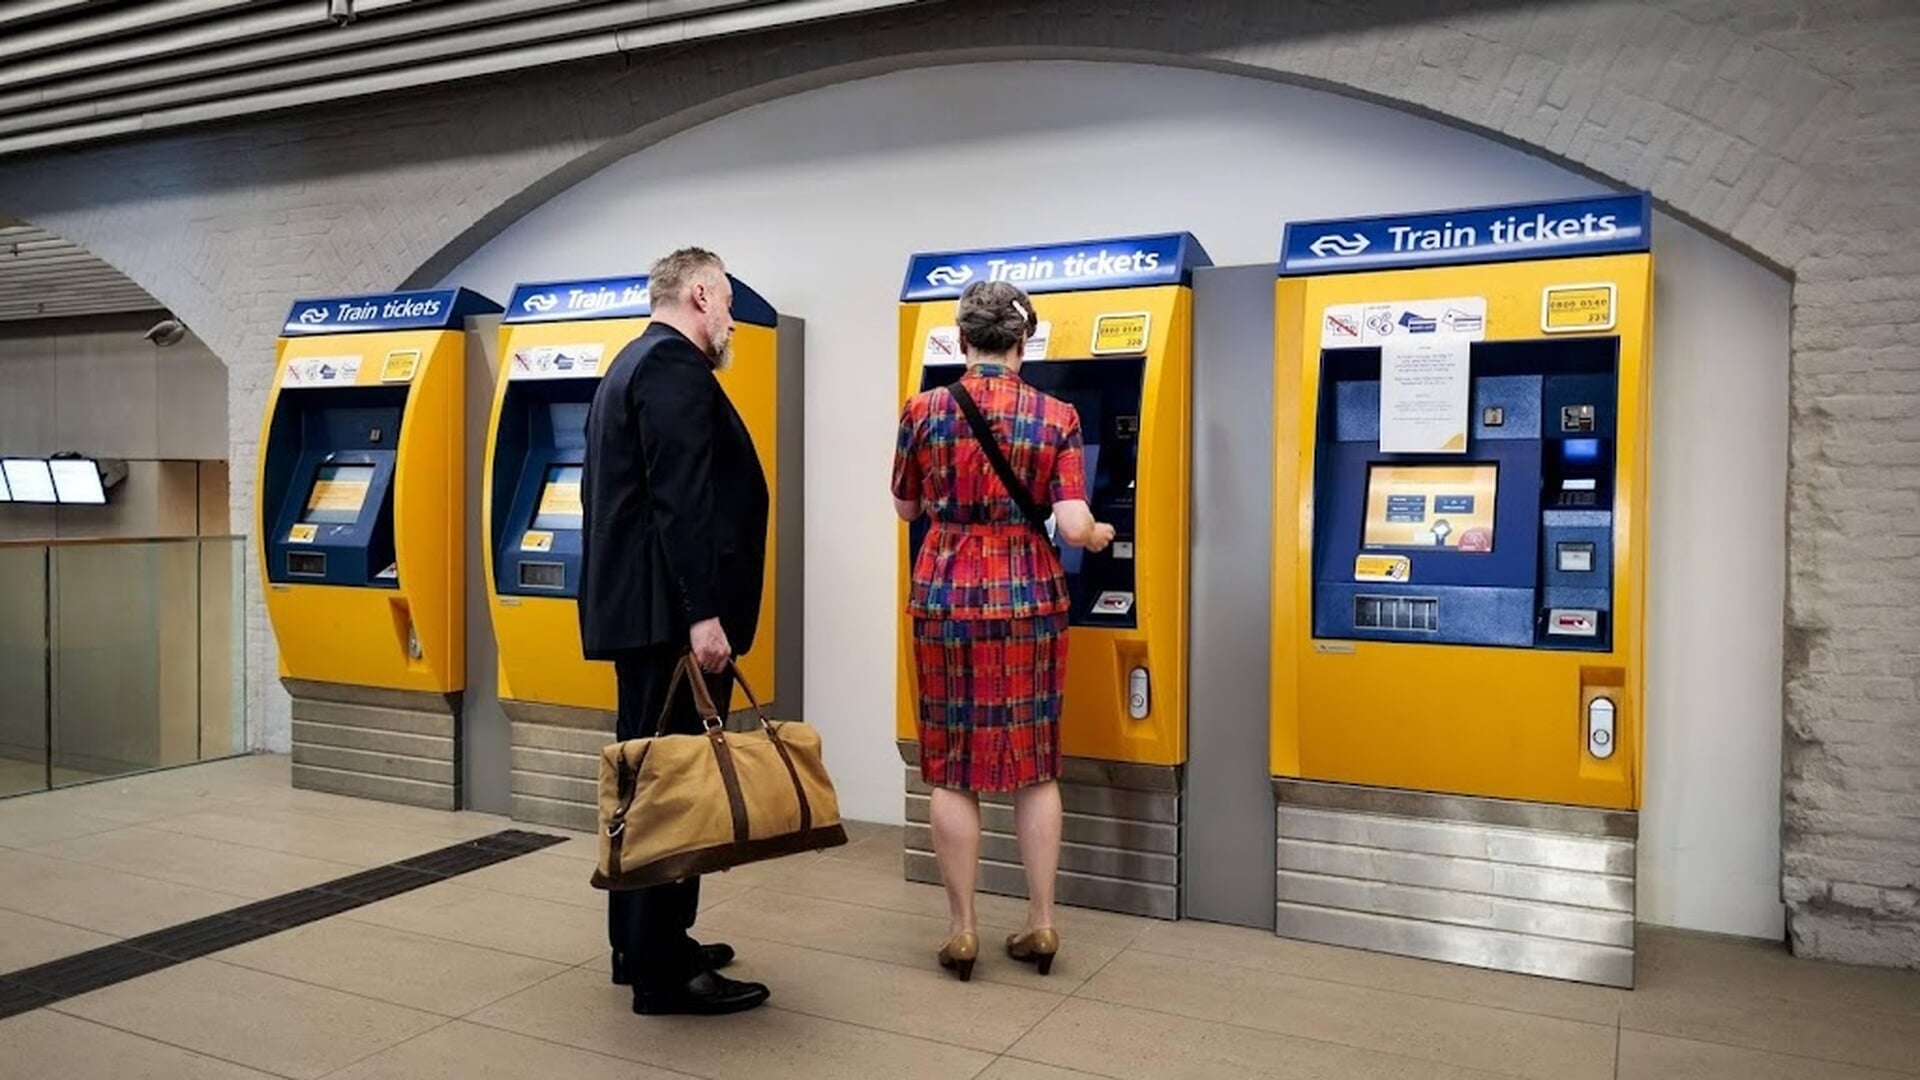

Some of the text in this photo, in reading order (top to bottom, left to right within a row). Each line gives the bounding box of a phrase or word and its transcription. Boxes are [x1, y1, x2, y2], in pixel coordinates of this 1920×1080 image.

[1388, 212, 1617, 252] Train tickets
[987, 249, 1159, 282] Train tickets
[336, 298, 441, 321] Train tickets
[567, 287, 616, 309] Train
